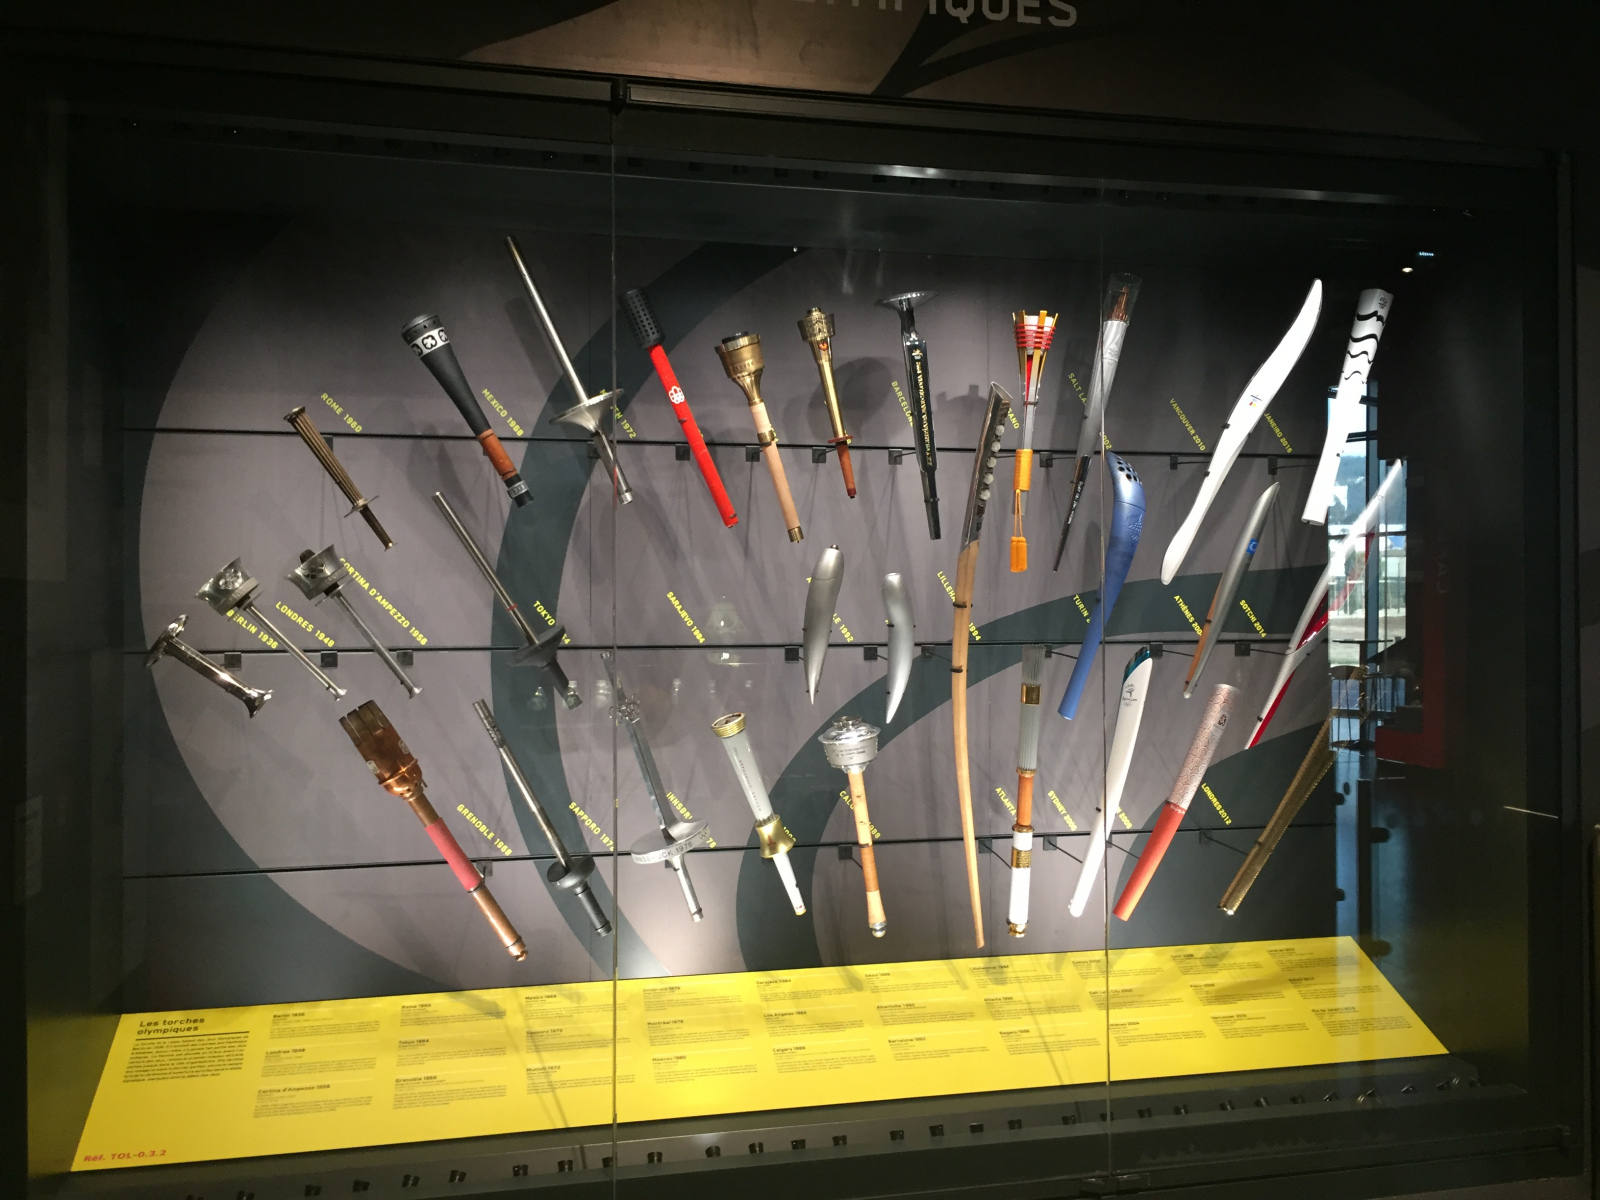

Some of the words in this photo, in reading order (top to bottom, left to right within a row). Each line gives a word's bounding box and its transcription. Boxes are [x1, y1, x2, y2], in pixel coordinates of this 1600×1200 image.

[1067, 372, 1082, 392] SALT
[320, 392, 344, 416] ROME
[343, 413, 363, 433] 1960
[482, 388, 508, 418] MEXICO
[506, 416, 525, 437] 1968
[1169, 398, 1196, 436] VANCOUVER
[1192, 434, 1206, 451] 2010
[1264, 412, 1283, 438] JANEIRO
[620, 418, 637, 439] 1972
[368, 588, 410, 628] D'AMPEZZO
[408, 626, 428, 646] 1956
[533, 600, 556, 626] TOKYO
[666, 591, 694, 627] SARAJEVO
[691, 625, 706, 644] 1984
[1073, 594, 1089, 617] TURIN
[1239, 599, 1258, 623] SOTCHI
[1253, 621, 1267, 638] 2014
[275, 601, 314, 632] LONDRES
[314, 630, 336, 648] 1948
[839, 623, 855, 643] 1992
[968, 622, 982, 641] 1994
[1191, 621, 1204, 637] 200
[258, 631, 279, 650] 1936
[666, 791, 693, 820] INNSBR
[995, 787, 1017, 816] ATLANTA
[1047, 790, 1068, 815] SYDNEY
[1063, 811, 1078, 832] 2000
[1201, 782, 1222, 811] LONDRES
[1218, 808, 1232, 826] 2012
[456, 803, 495, 840] GRENOBLE
[494, 837, 513, 857] 1968
[568, 801, 602, 835] SAPPORO
[137, 1025, 199, 1036] olympiques
[139, 1019, 159, 1028] Les
[162, 1017, 205, 1027] torches
